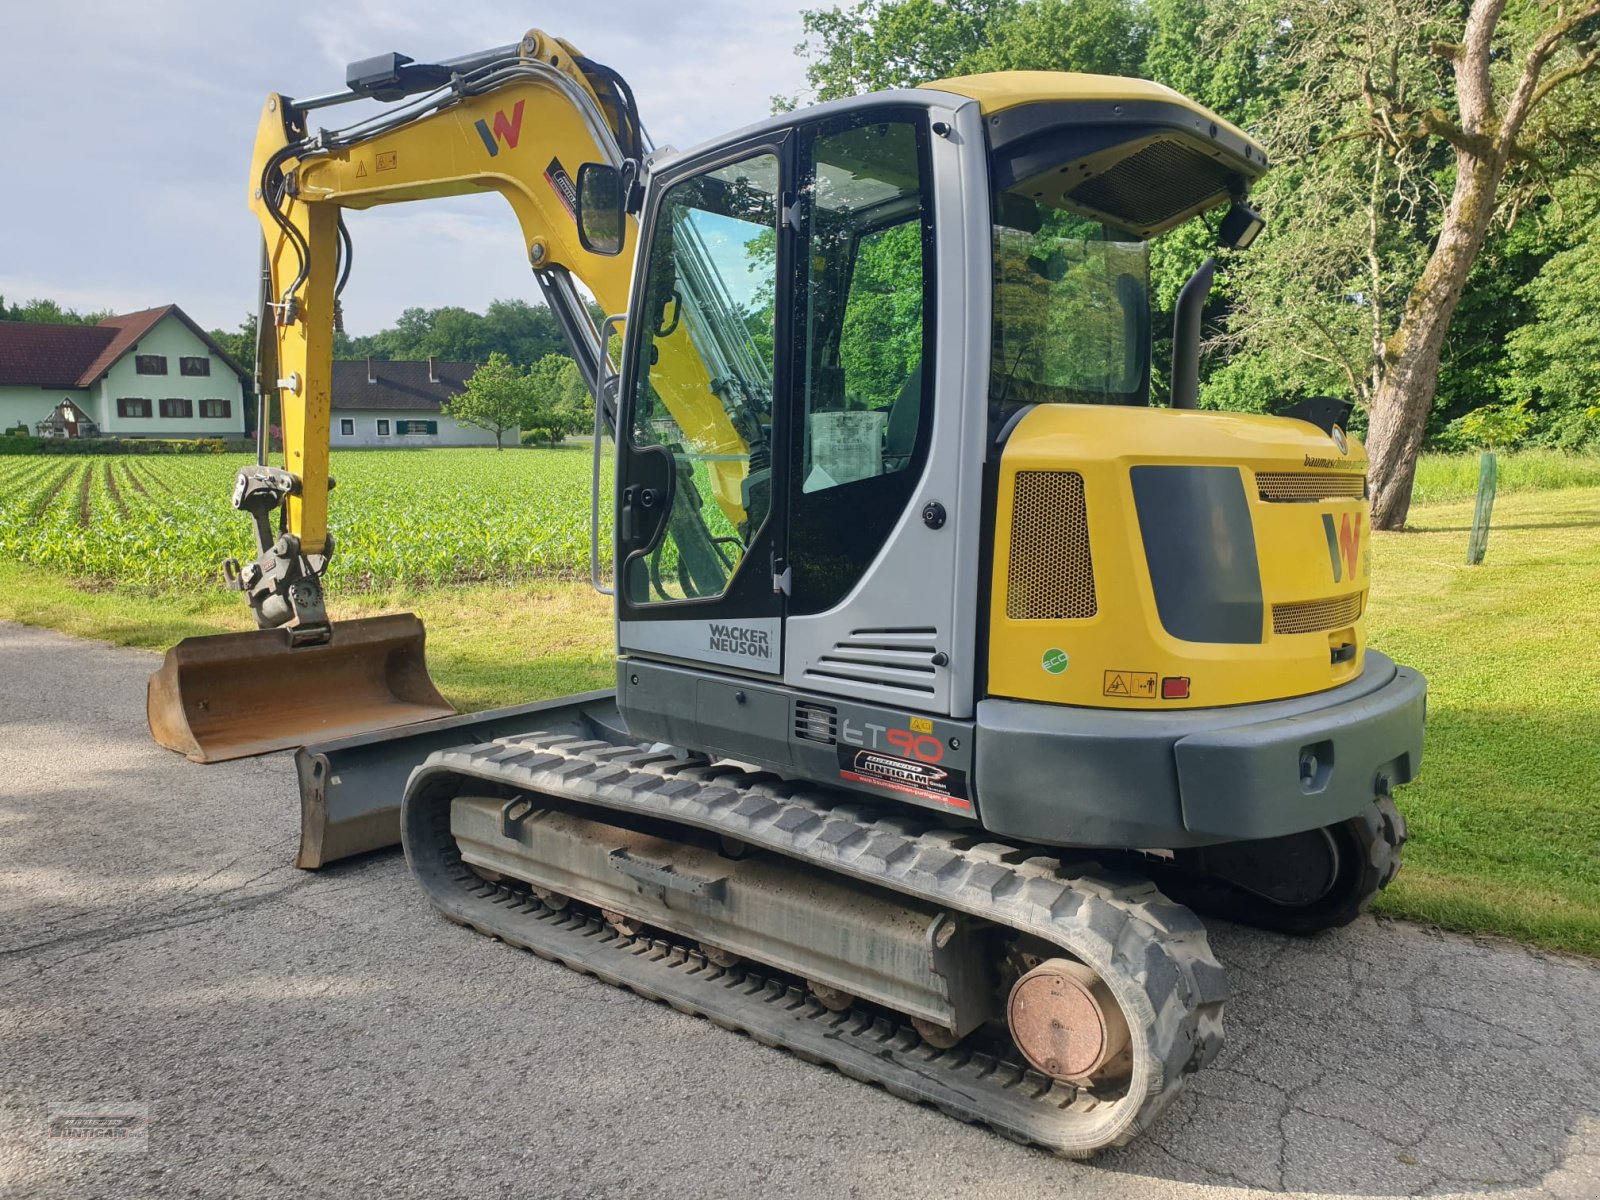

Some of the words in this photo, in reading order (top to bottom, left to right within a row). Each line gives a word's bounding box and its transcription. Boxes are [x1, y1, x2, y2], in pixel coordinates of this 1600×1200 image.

[709, 623, 768, 644] WACKER
[709, 637, 769, 658] NEUSON
[1042, 653, 1069, 671] ECO
[842, 719, 944, 763] ET90
